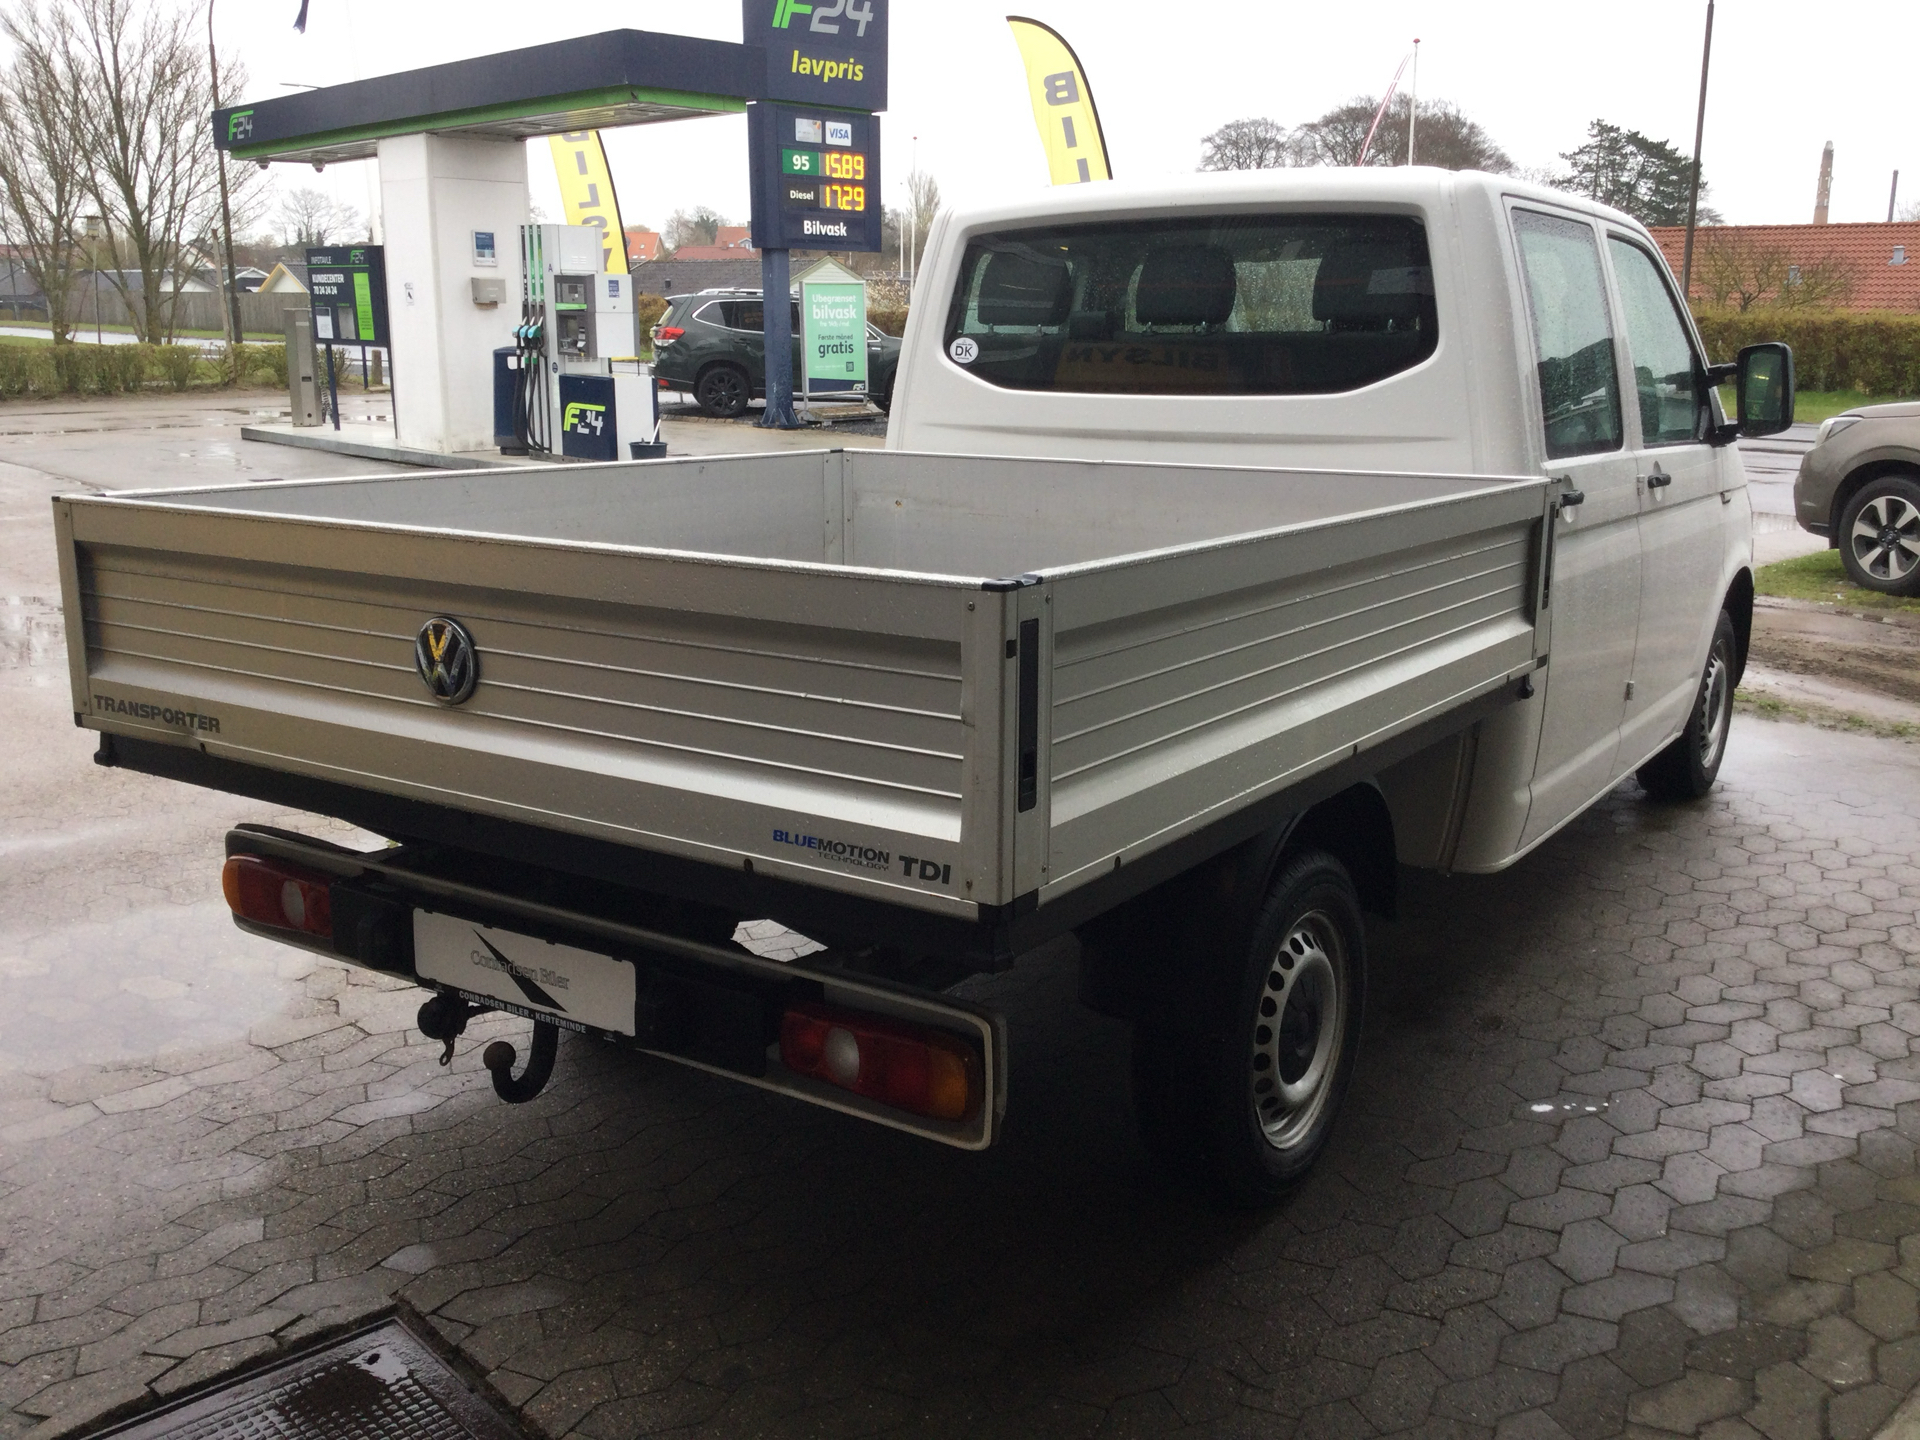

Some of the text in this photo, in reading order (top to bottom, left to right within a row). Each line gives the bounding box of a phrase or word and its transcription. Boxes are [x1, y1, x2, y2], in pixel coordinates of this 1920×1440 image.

[791, 50, 864, 83] lavpris
[228, 110, 254, 141] F24
[829, 128, 850, 140] VISA
[792, 155, 810, 171] 95
[789, 190, 814, 201] Diesel
[803, 220, 847, 237] Bilvask
[312, 273, 345, 284] KUNDECENTER
[812, 294, 857, 305] Ubegrænset
[812, 304, 857, 319] bilvask
[818, 341, 854, 358] gratis
[955, 345, 973, 358] DK
[563, 402, 606, 436] F24
[93, 694, 221, 733] TRANSPORTER
[772, 829, 952, 885] BLUEMOTION TDI
[817, 851, 890, 872] TECHNOLOGY
[470, 950, 570, 990] Conradsen Biler
[459, 990, 587, 1034] CONRADSEN BILER KERTEMINDE
